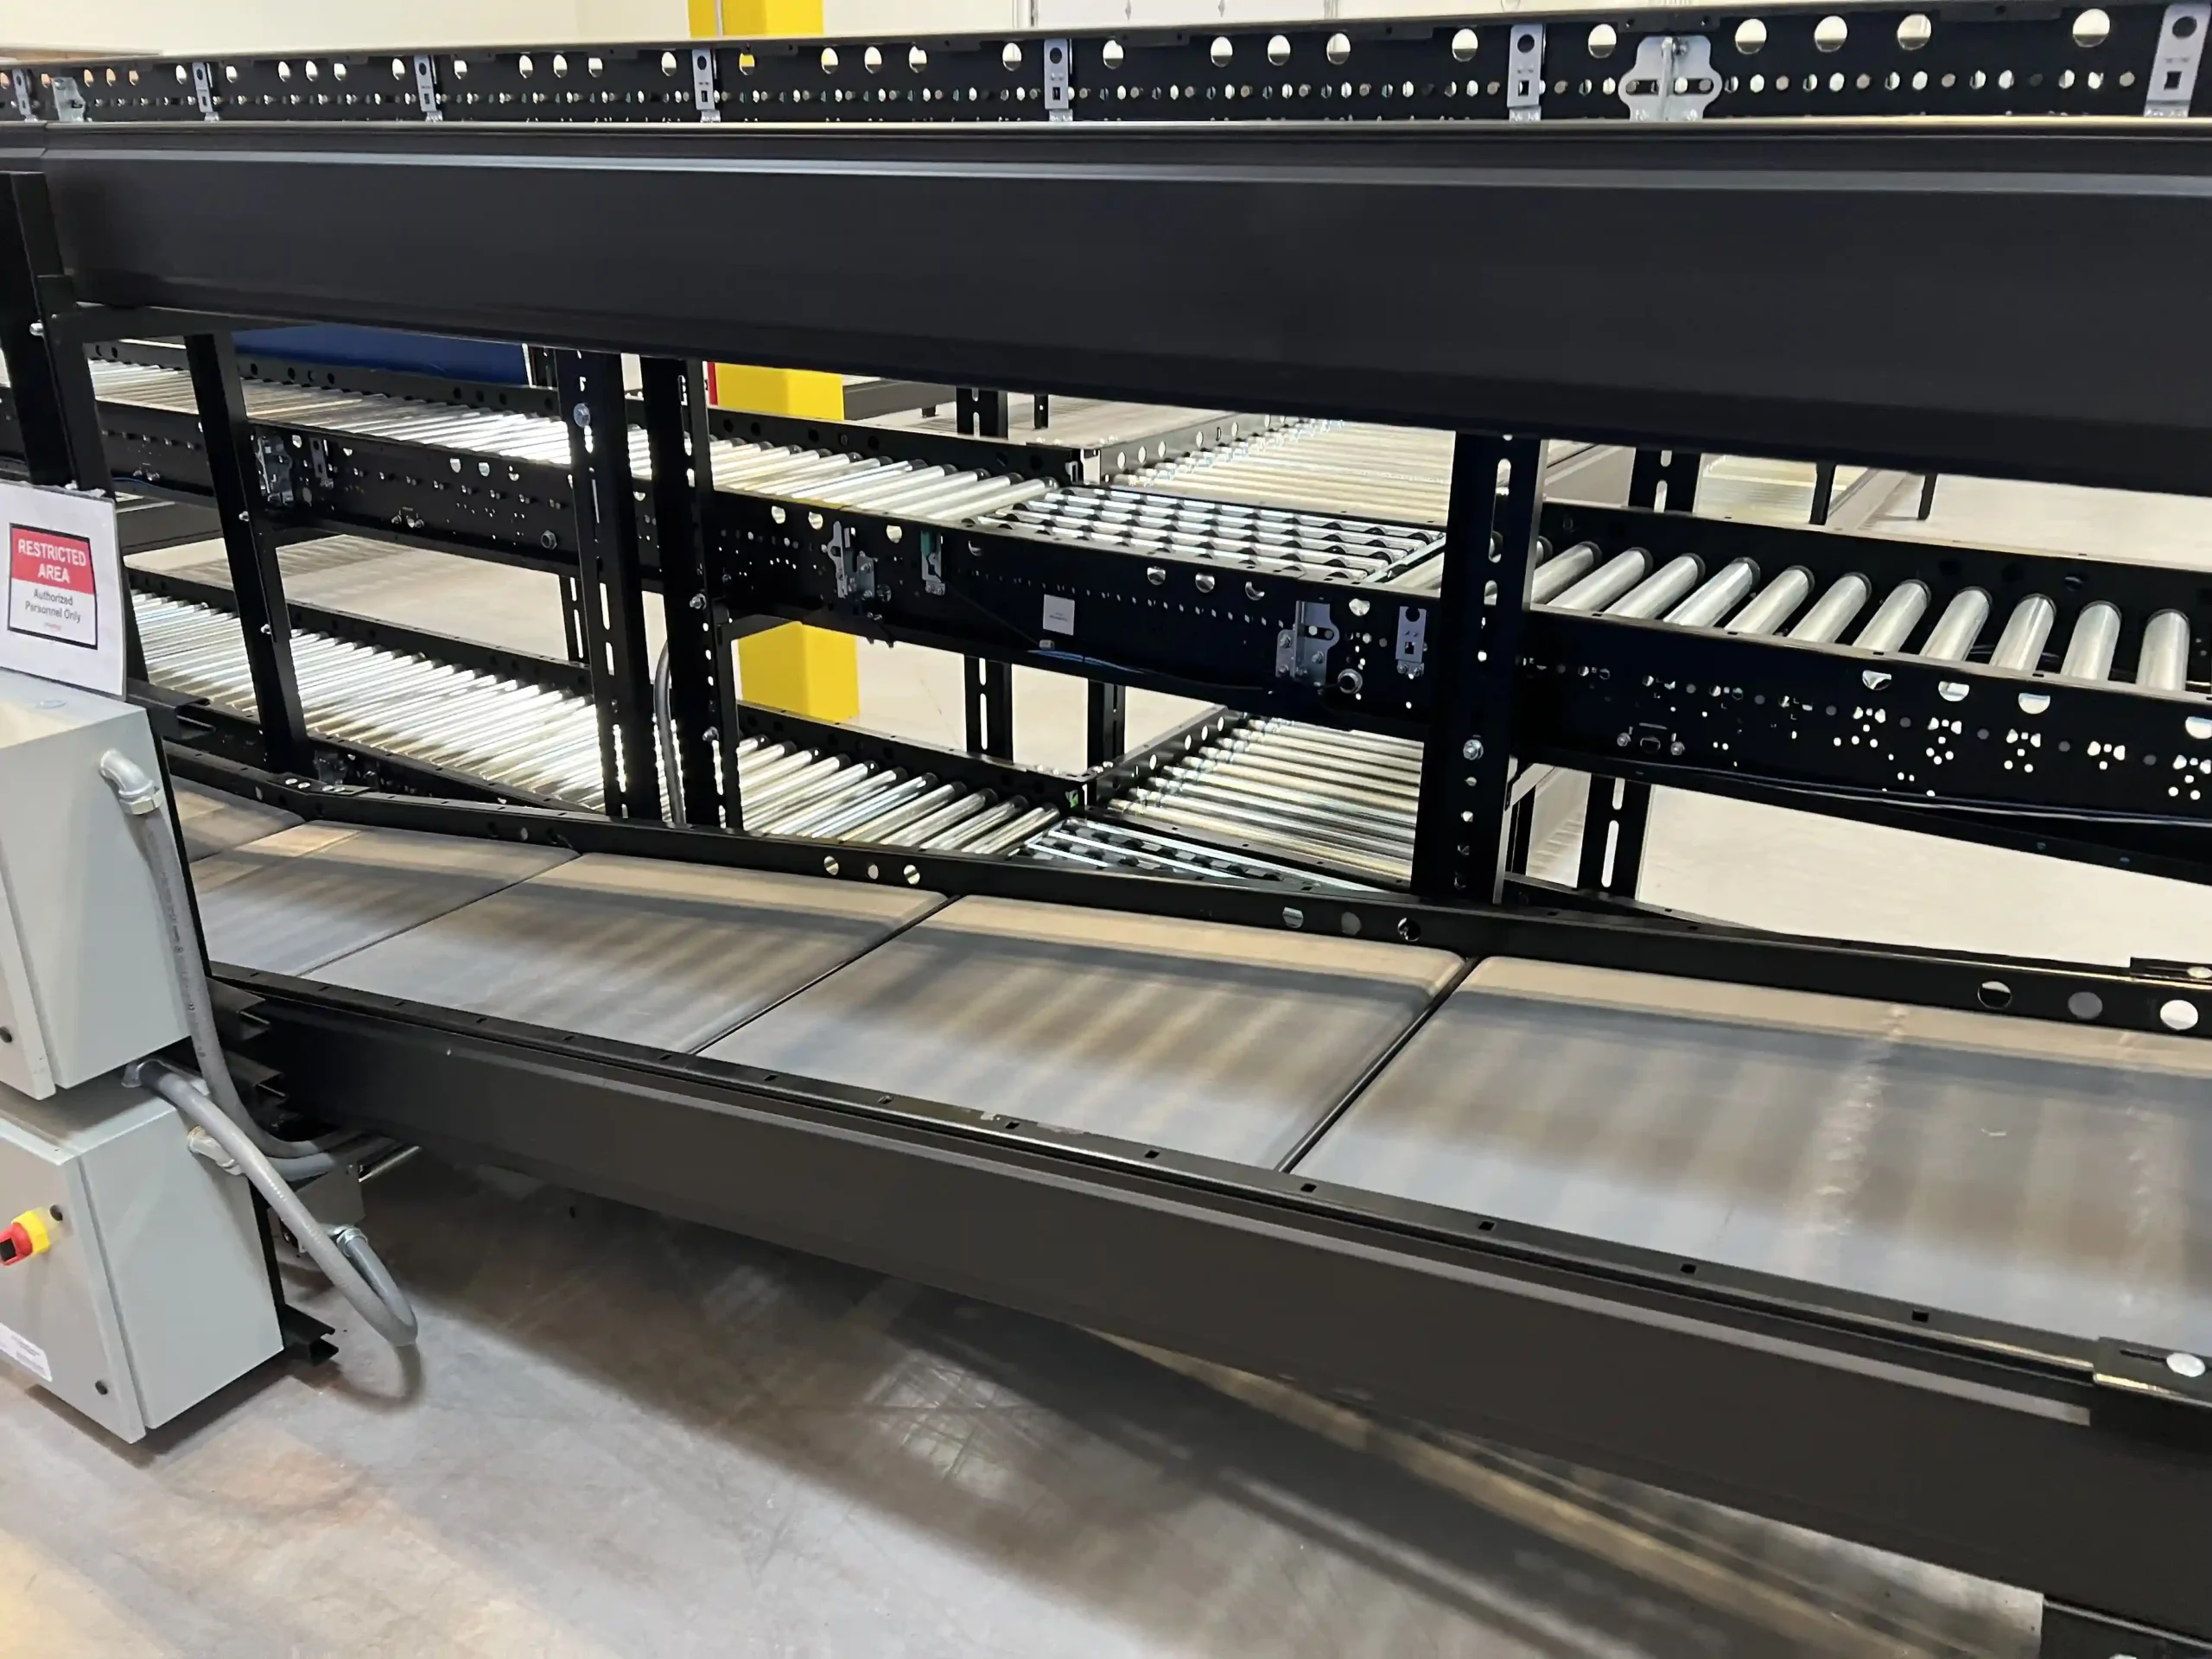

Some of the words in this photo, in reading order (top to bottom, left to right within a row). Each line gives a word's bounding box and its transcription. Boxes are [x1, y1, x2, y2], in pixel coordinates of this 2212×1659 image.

[18, 539, 86, 566] RESTRICTED
[38, 563, 70, 584] AREA
[34, 588, 73, 605] Authorized
[25, 601, 61, 618] Personnel
[64, 609, 80, 623] Only
